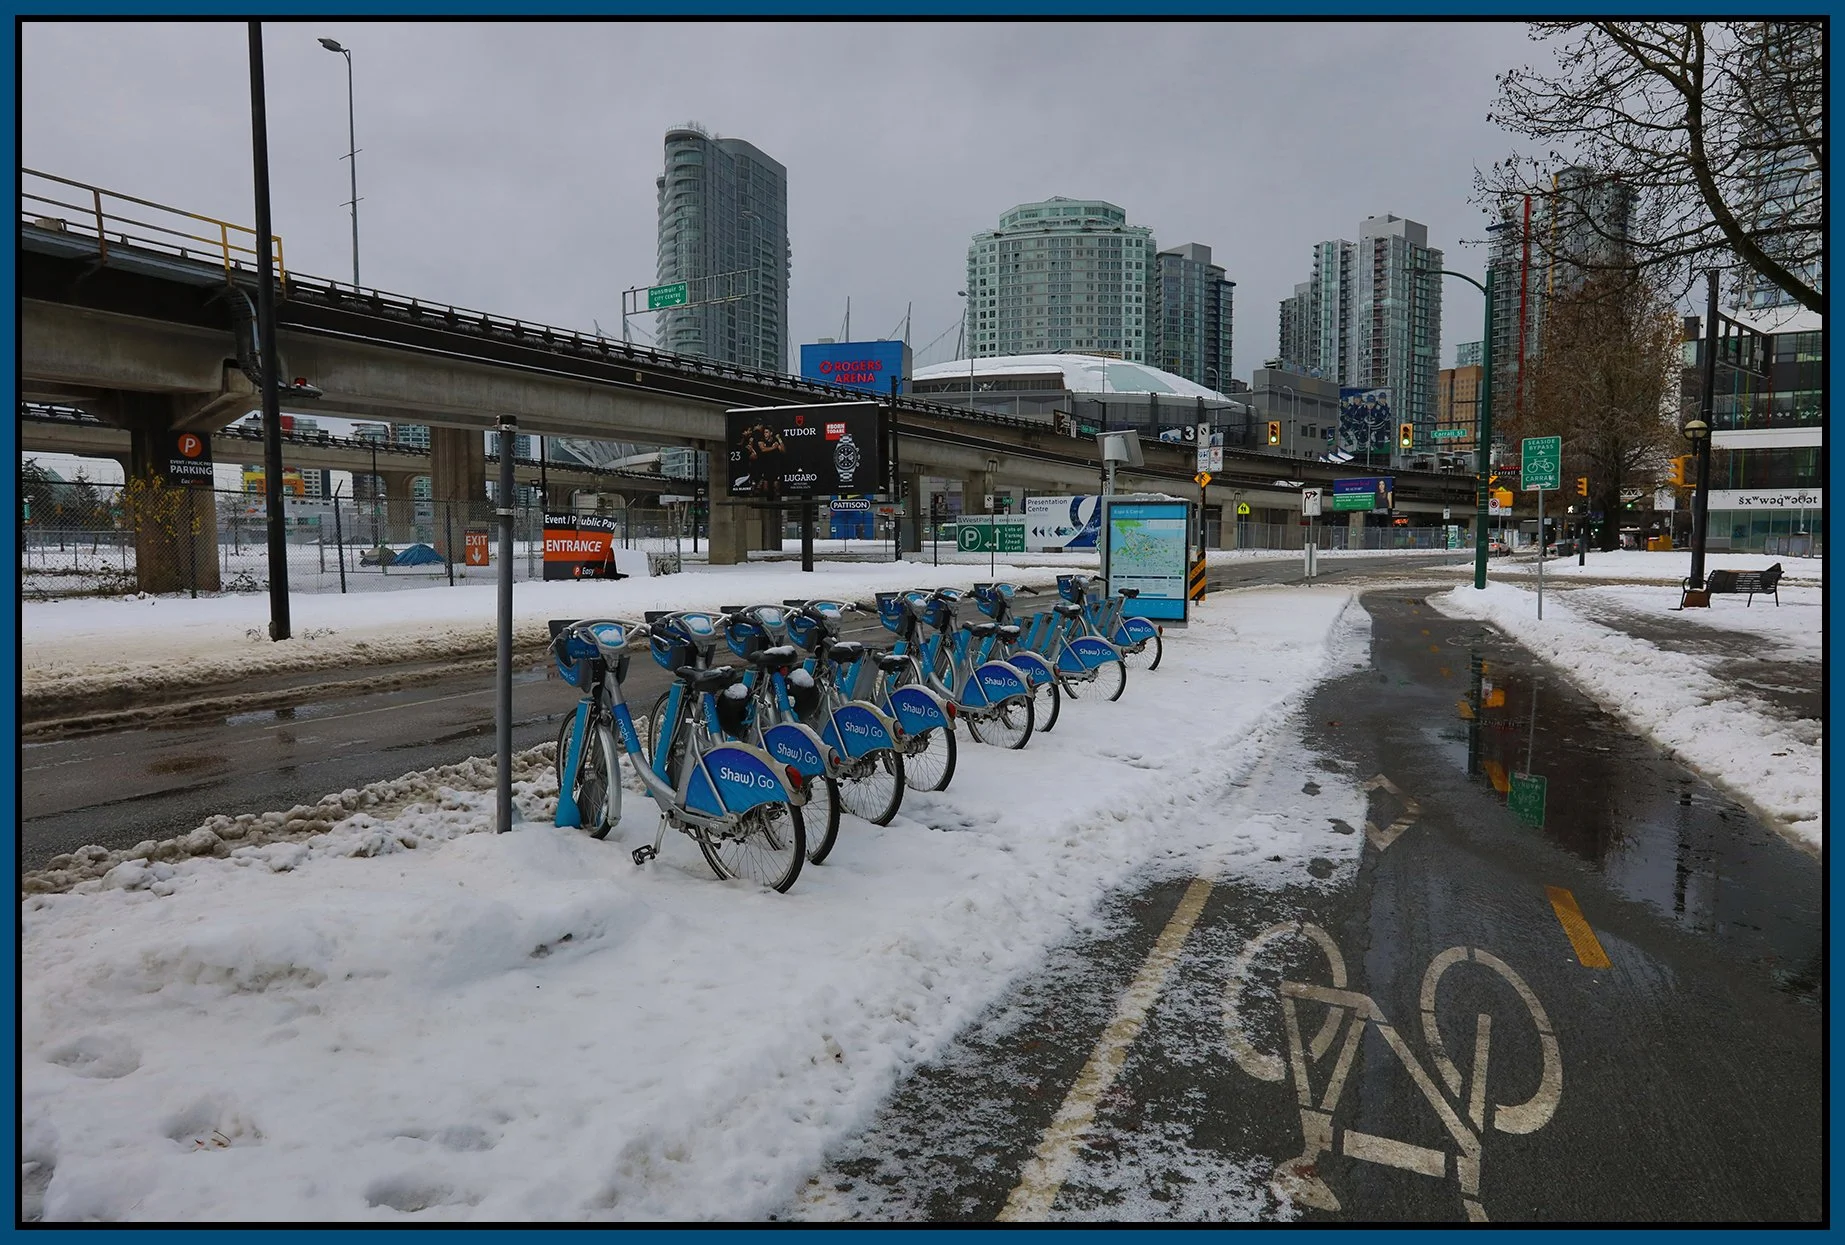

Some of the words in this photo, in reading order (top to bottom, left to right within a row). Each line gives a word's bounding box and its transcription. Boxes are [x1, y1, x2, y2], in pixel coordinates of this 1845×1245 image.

[650, 286, 677, 296] Dunsmuir
[664, 292, 681, 300] CENTRE
[834, 360, 883, 372] ROGERS
[835, 373, 875, 383] ARENA
[783, 427, 817, 437] TUDOR
[1184, 426, 1195, 441] 3
[730, 451, 741, 461] 23
[170, 465, 213, 475] PARKING
[784, 474, 818, 482] LUGARO
[833, 501, 868, 509] PATTISON
[545, 514, 566, 524] Event
[601, 519, 617, 530] Pay
[465, 536, 487, 546] EXIT
[965, 530, 978, 547] P
[546, 539, 602, 552] ENTRANCE
[1007, 679, 1018, 687] Go
[927, 707, 939, 718] Go
[870, 726, 883, 738] Go
[804, 751, 818, 765] Go
[757, 774, 774, 789] Go
